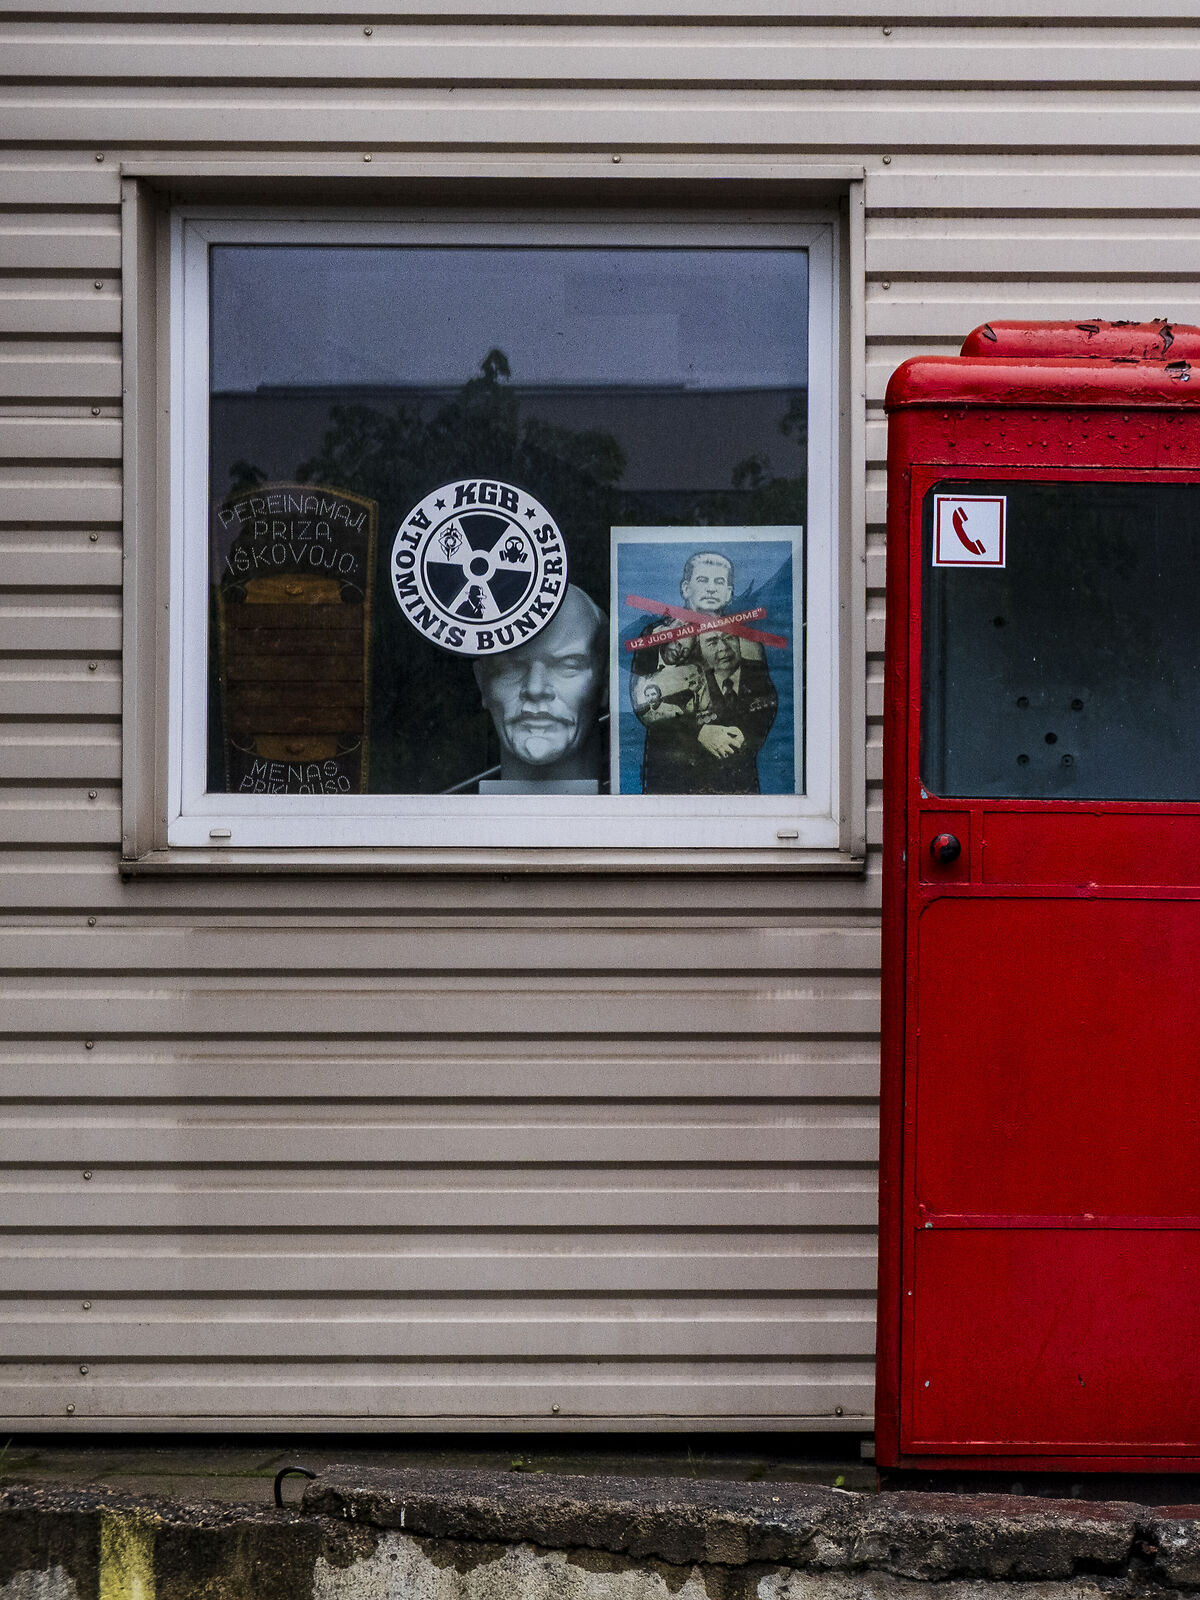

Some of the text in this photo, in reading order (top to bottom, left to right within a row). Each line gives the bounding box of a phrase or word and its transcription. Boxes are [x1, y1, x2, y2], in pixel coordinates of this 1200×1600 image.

[452, 482, 520, 515] KGB
[395, 507, 563, 651] ATOMINIS BUNKERIS
[647, 631, 674, 644] JUOS
[676, 625, 695, 638] JAU
[250, 759, 338, 783] MENAS
